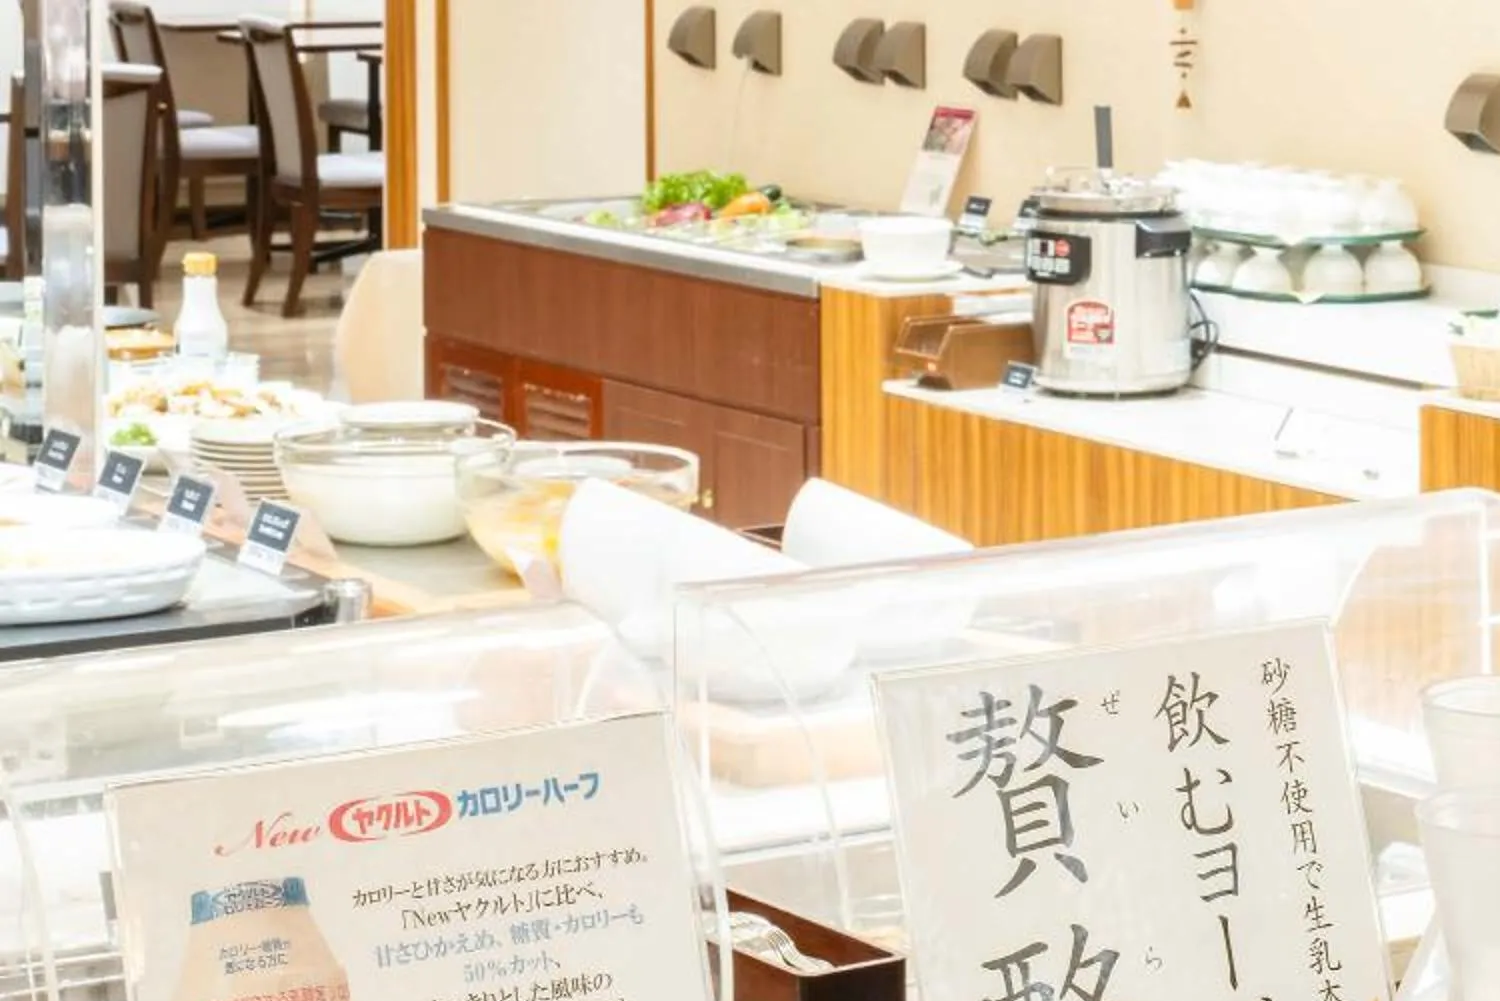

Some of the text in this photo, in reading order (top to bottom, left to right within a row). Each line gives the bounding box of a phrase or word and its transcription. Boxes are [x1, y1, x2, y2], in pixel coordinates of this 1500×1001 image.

[214, 772, 600, 857] New ヤクルト カロリーハーフ
